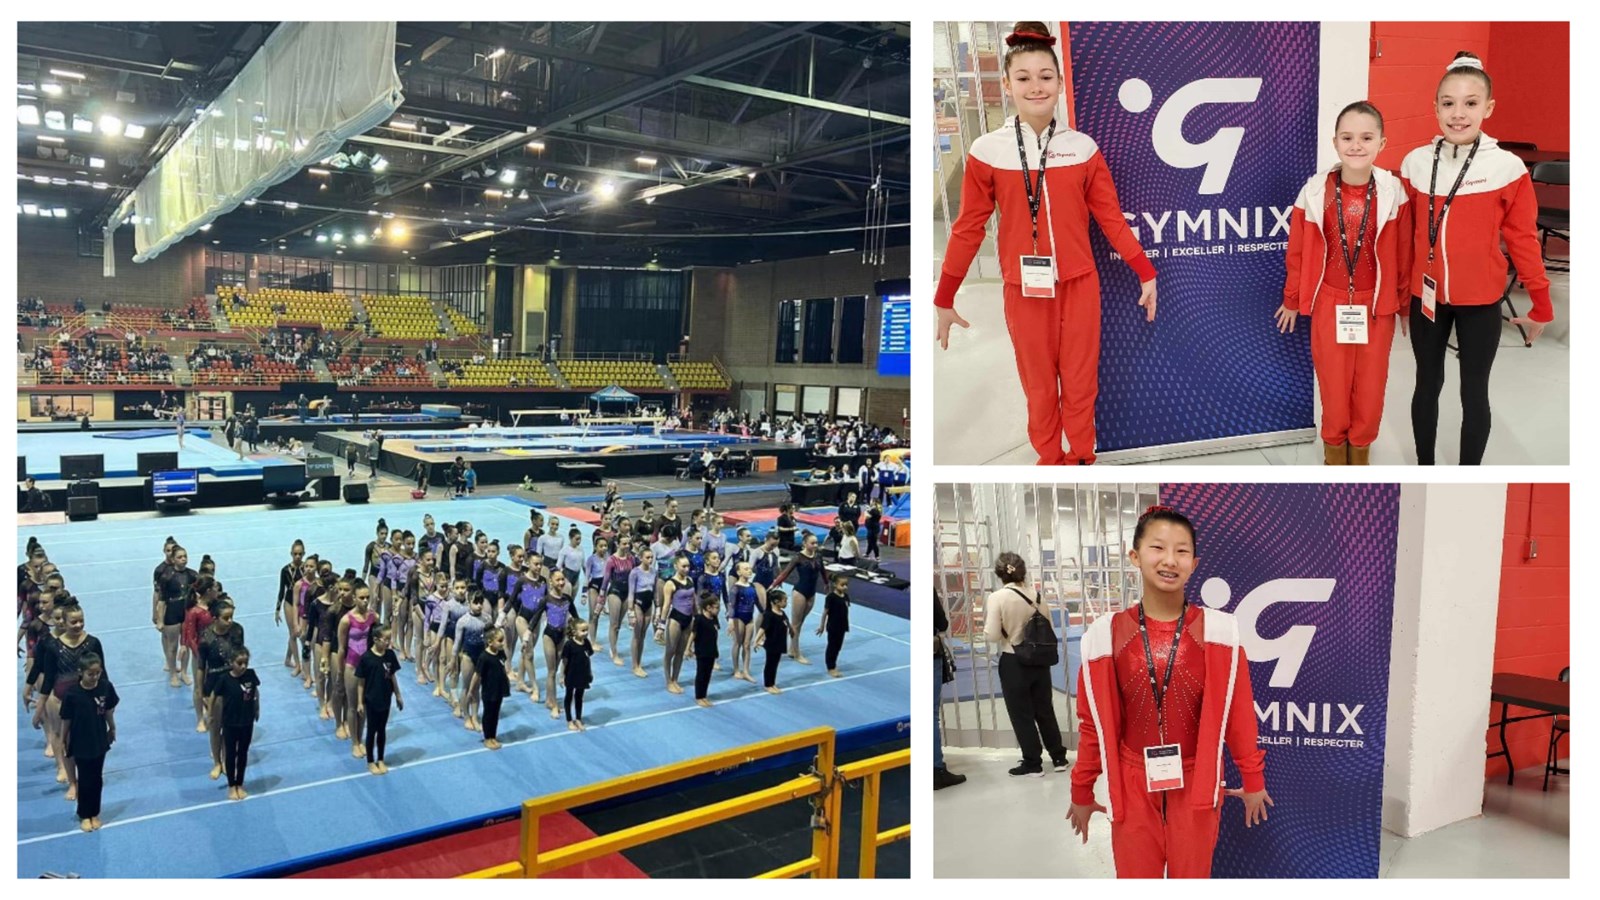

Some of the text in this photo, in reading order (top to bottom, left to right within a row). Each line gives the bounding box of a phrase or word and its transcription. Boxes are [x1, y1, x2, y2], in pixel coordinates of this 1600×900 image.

[1172, 245, 1225, 257] EXCELLER
[1237, 241, 1289, 253] RESPECTE
[1253, 700, 1365, 735] MNIX
[1256, 736, 1364, 748] CELLER RESPECTER
